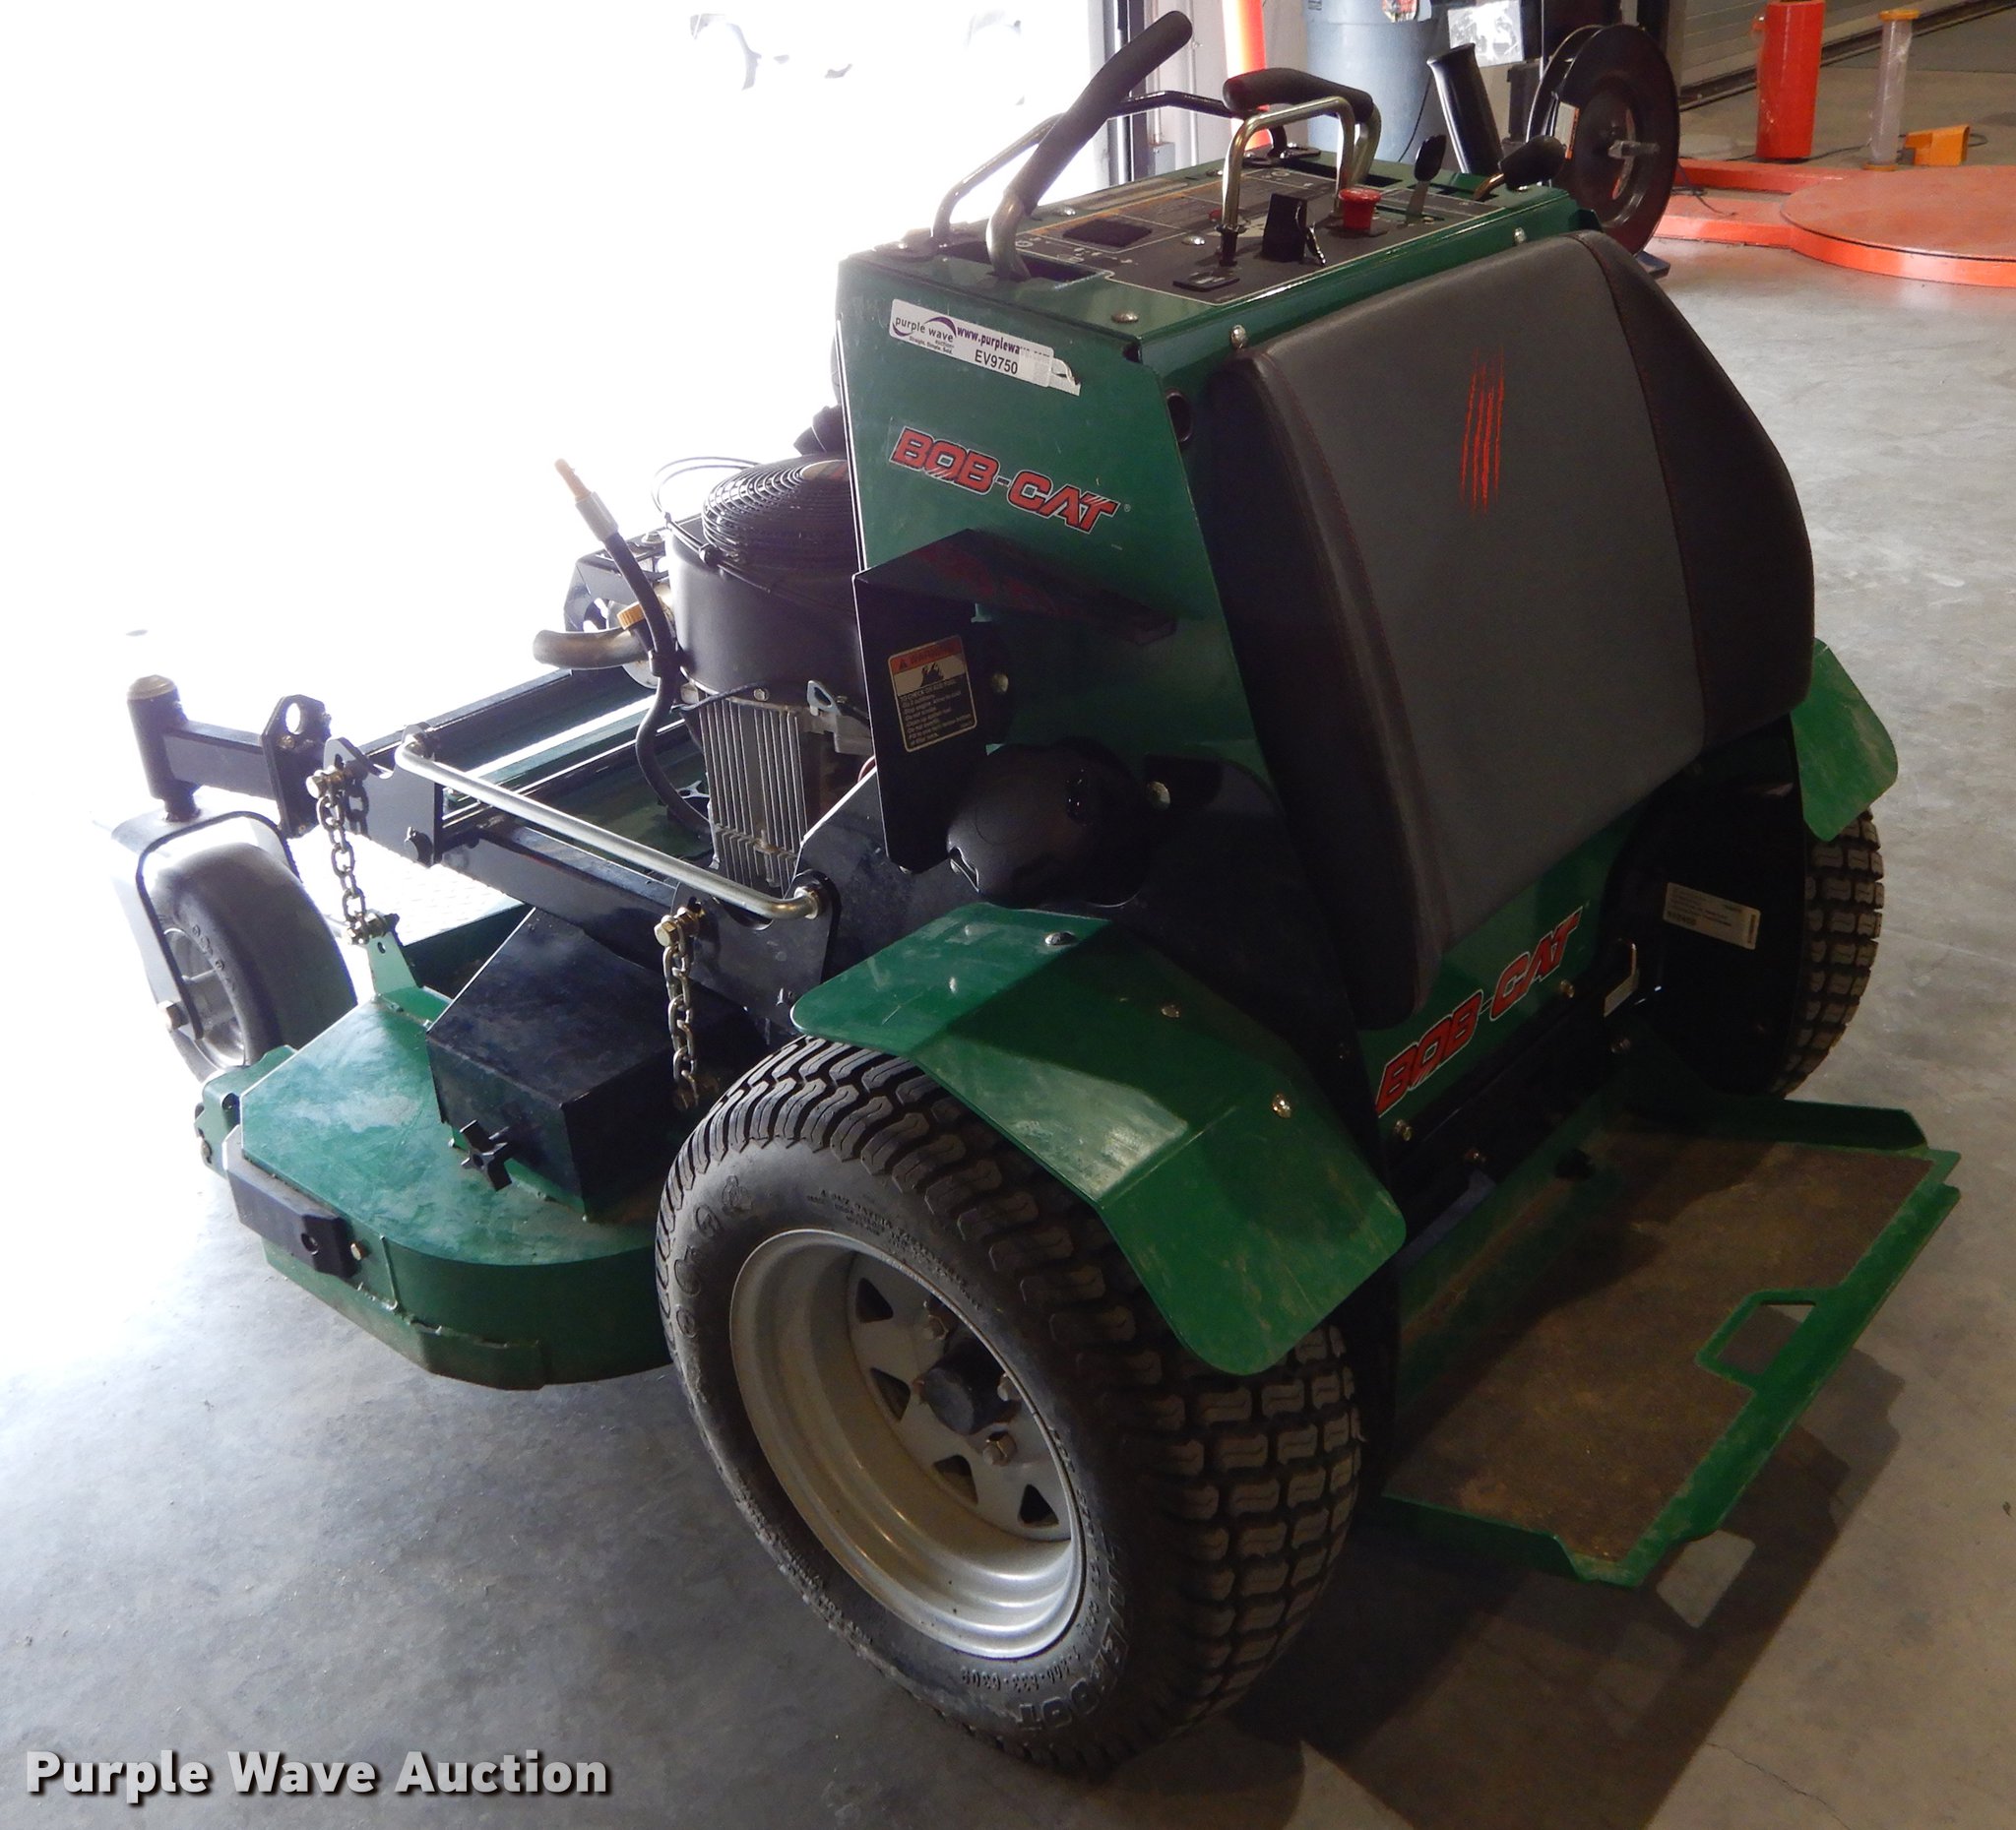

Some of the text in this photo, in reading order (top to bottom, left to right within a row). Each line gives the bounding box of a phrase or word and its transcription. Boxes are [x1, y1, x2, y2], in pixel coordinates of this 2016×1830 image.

[895, 316, 954, 343] purple wave
[956, 326, 1050, 358] www.purplewa
[974, 348, 1018, 375] EV9750
[889, 425, 1121, 535] BOB-CAT
[1375, 906, 1583, 1118] BOB-CAT
